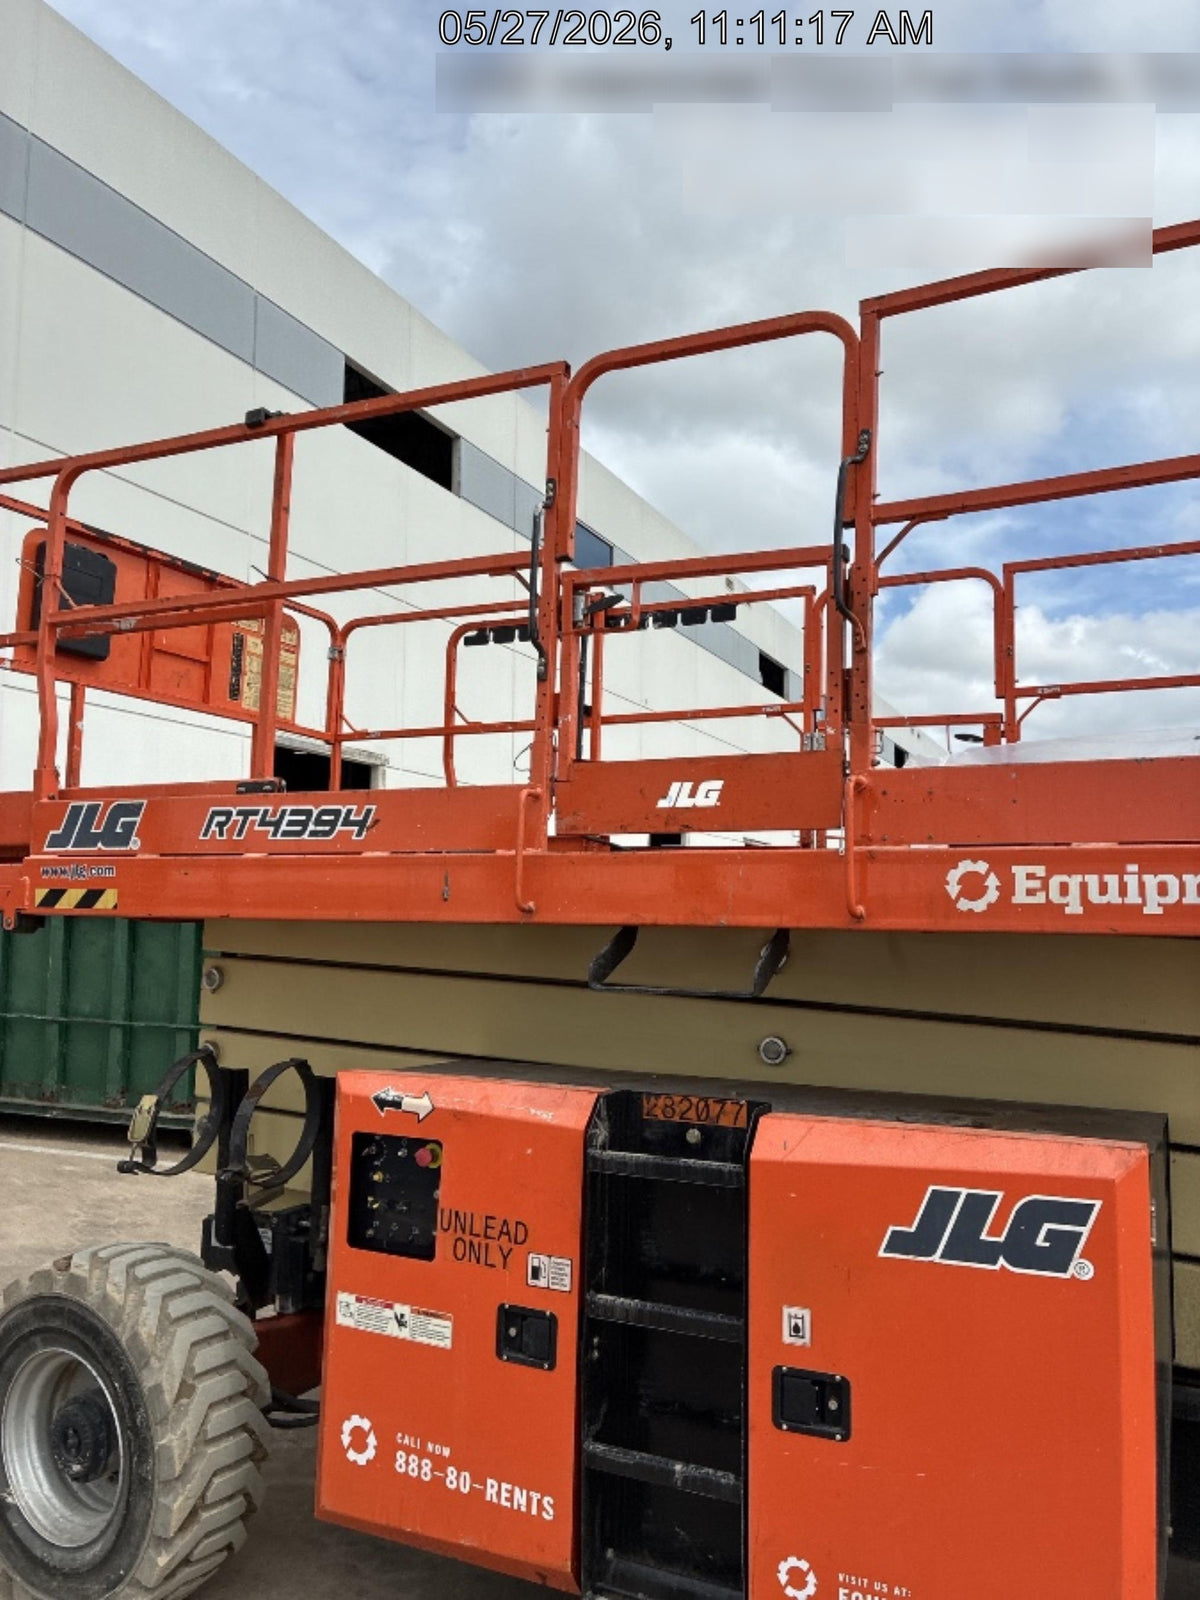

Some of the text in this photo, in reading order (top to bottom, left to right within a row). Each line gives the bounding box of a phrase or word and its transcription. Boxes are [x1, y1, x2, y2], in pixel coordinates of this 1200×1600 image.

[656, 780, 724, 808] JLG
[44, 800, 146, 851] JLG
[199, 805, 377, 840] RT4394
[41, 864, 116, 881] www.jlg.com
[440, 1208, 529, 1246] UNLEAD
[878, 1185, 1102, 1280] JLG
[453, 1237, 514, 1270] ONLY
[396, 1432, 451, 1459] CALL NOW
[395, 1451, 555, 1520] 888-80-RENTS
[838, 1572, 868, 1589] VISIT
[874, 1581, 888, 1594] US
